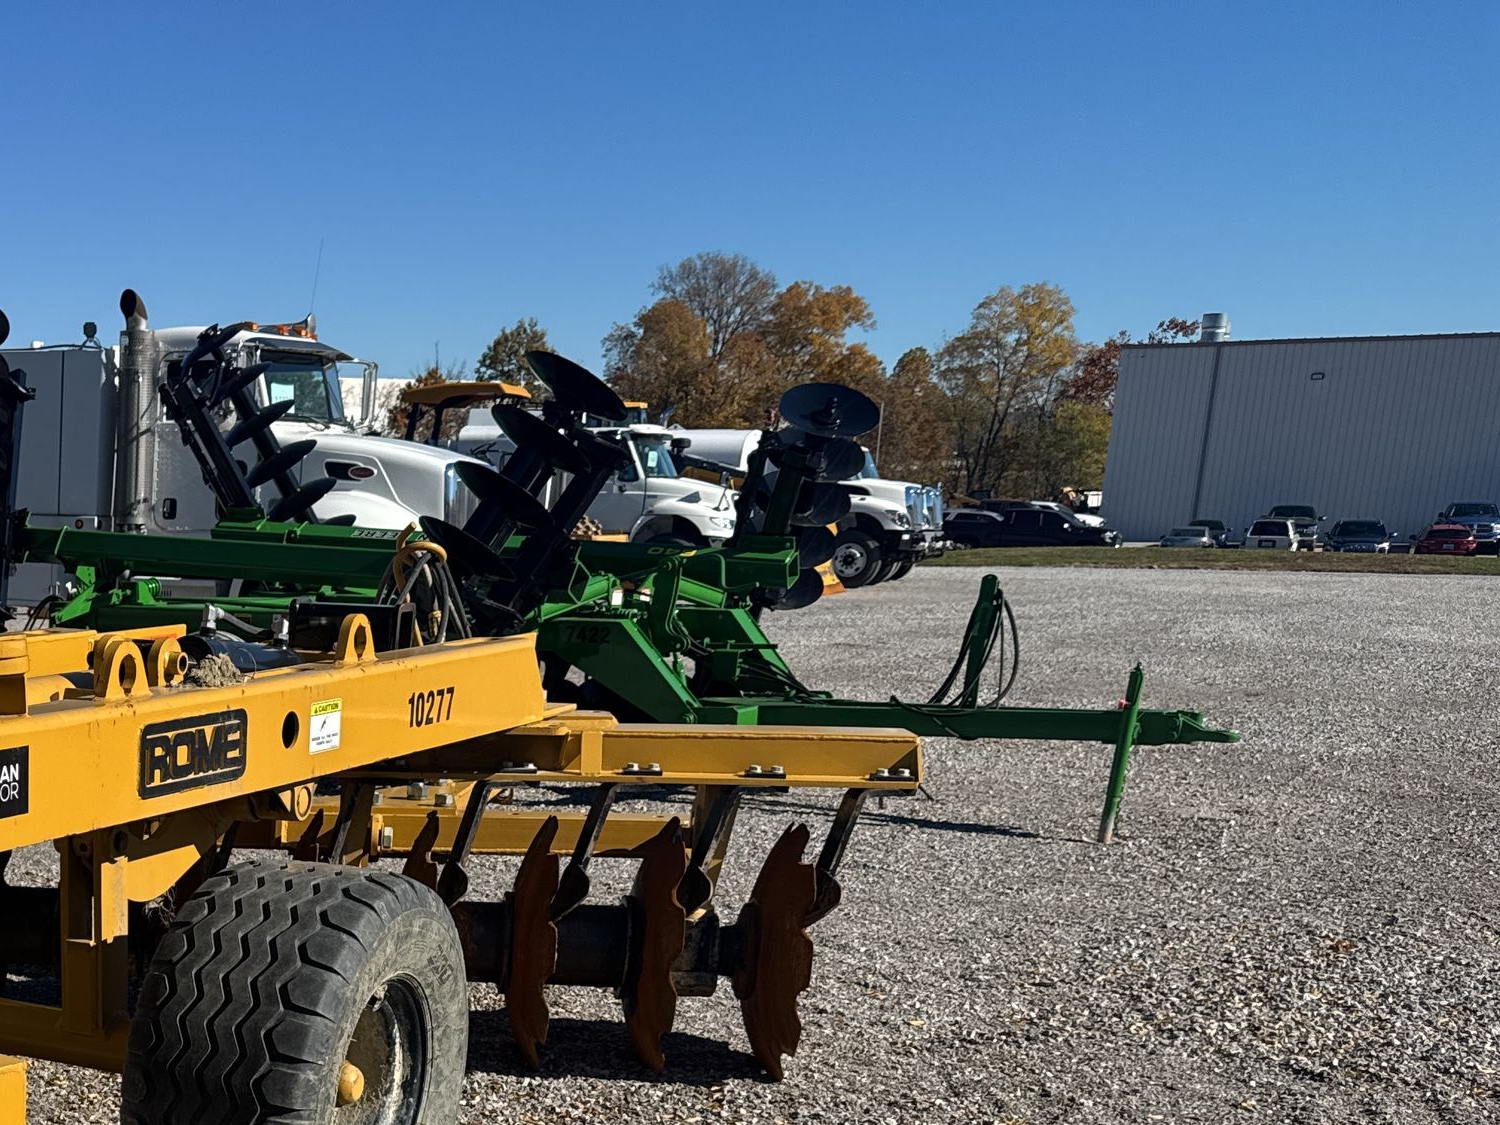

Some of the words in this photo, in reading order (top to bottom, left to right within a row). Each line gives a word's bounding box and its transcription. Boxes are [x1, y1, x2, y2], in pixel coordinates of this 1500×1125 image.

[351, 529, 402, 540] EERE
[566, 625, 611, 644] 7422
[318, 702, 339, 713] CAUTION
[408, 686, 455, 728] 10277
[145, 721, 243, 786] ROME
